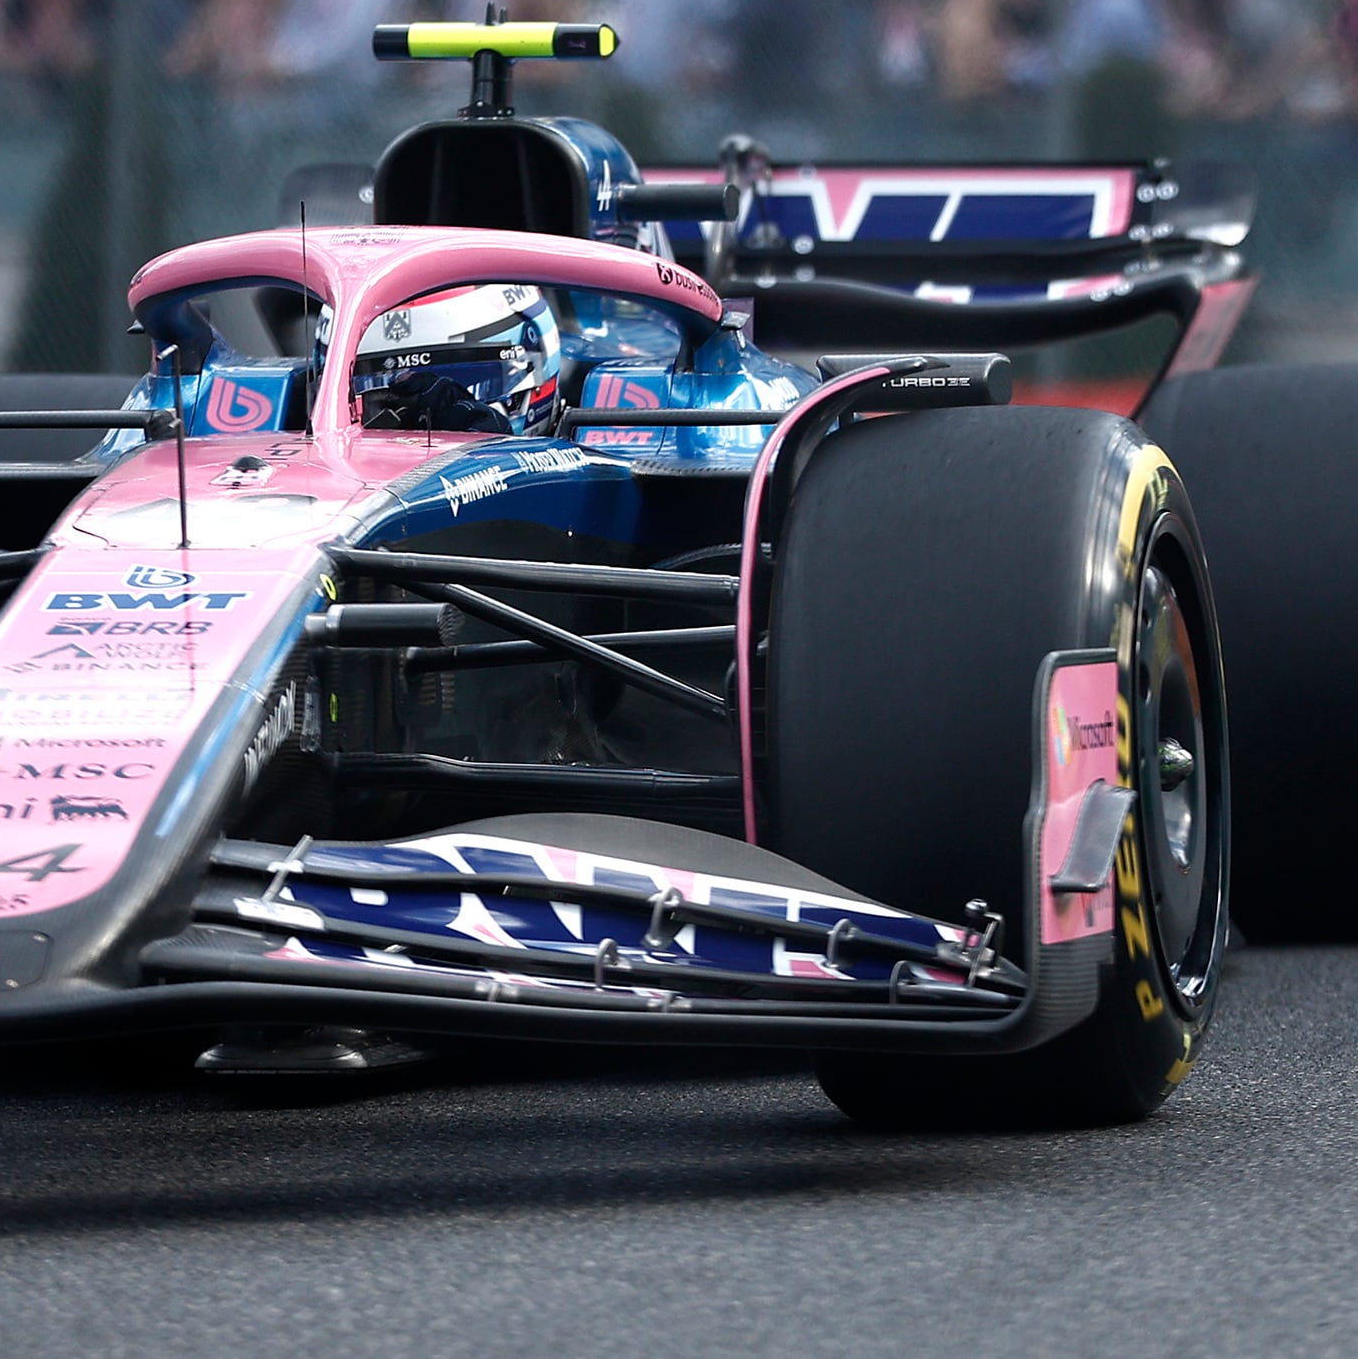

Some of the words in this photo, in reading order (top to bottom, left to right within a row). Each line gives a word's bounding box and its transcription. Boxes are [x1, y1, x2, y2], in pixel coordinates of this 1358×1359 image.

[397, 353, 431, 368] MSC
[584, 430, 655, 446] BWT
[44, 592, 247, 610] BWT
[103, 621, 214, 635] BRB
[14, 736, 168, 749] Microsoft
[12, 762, 157, 780] MSC
